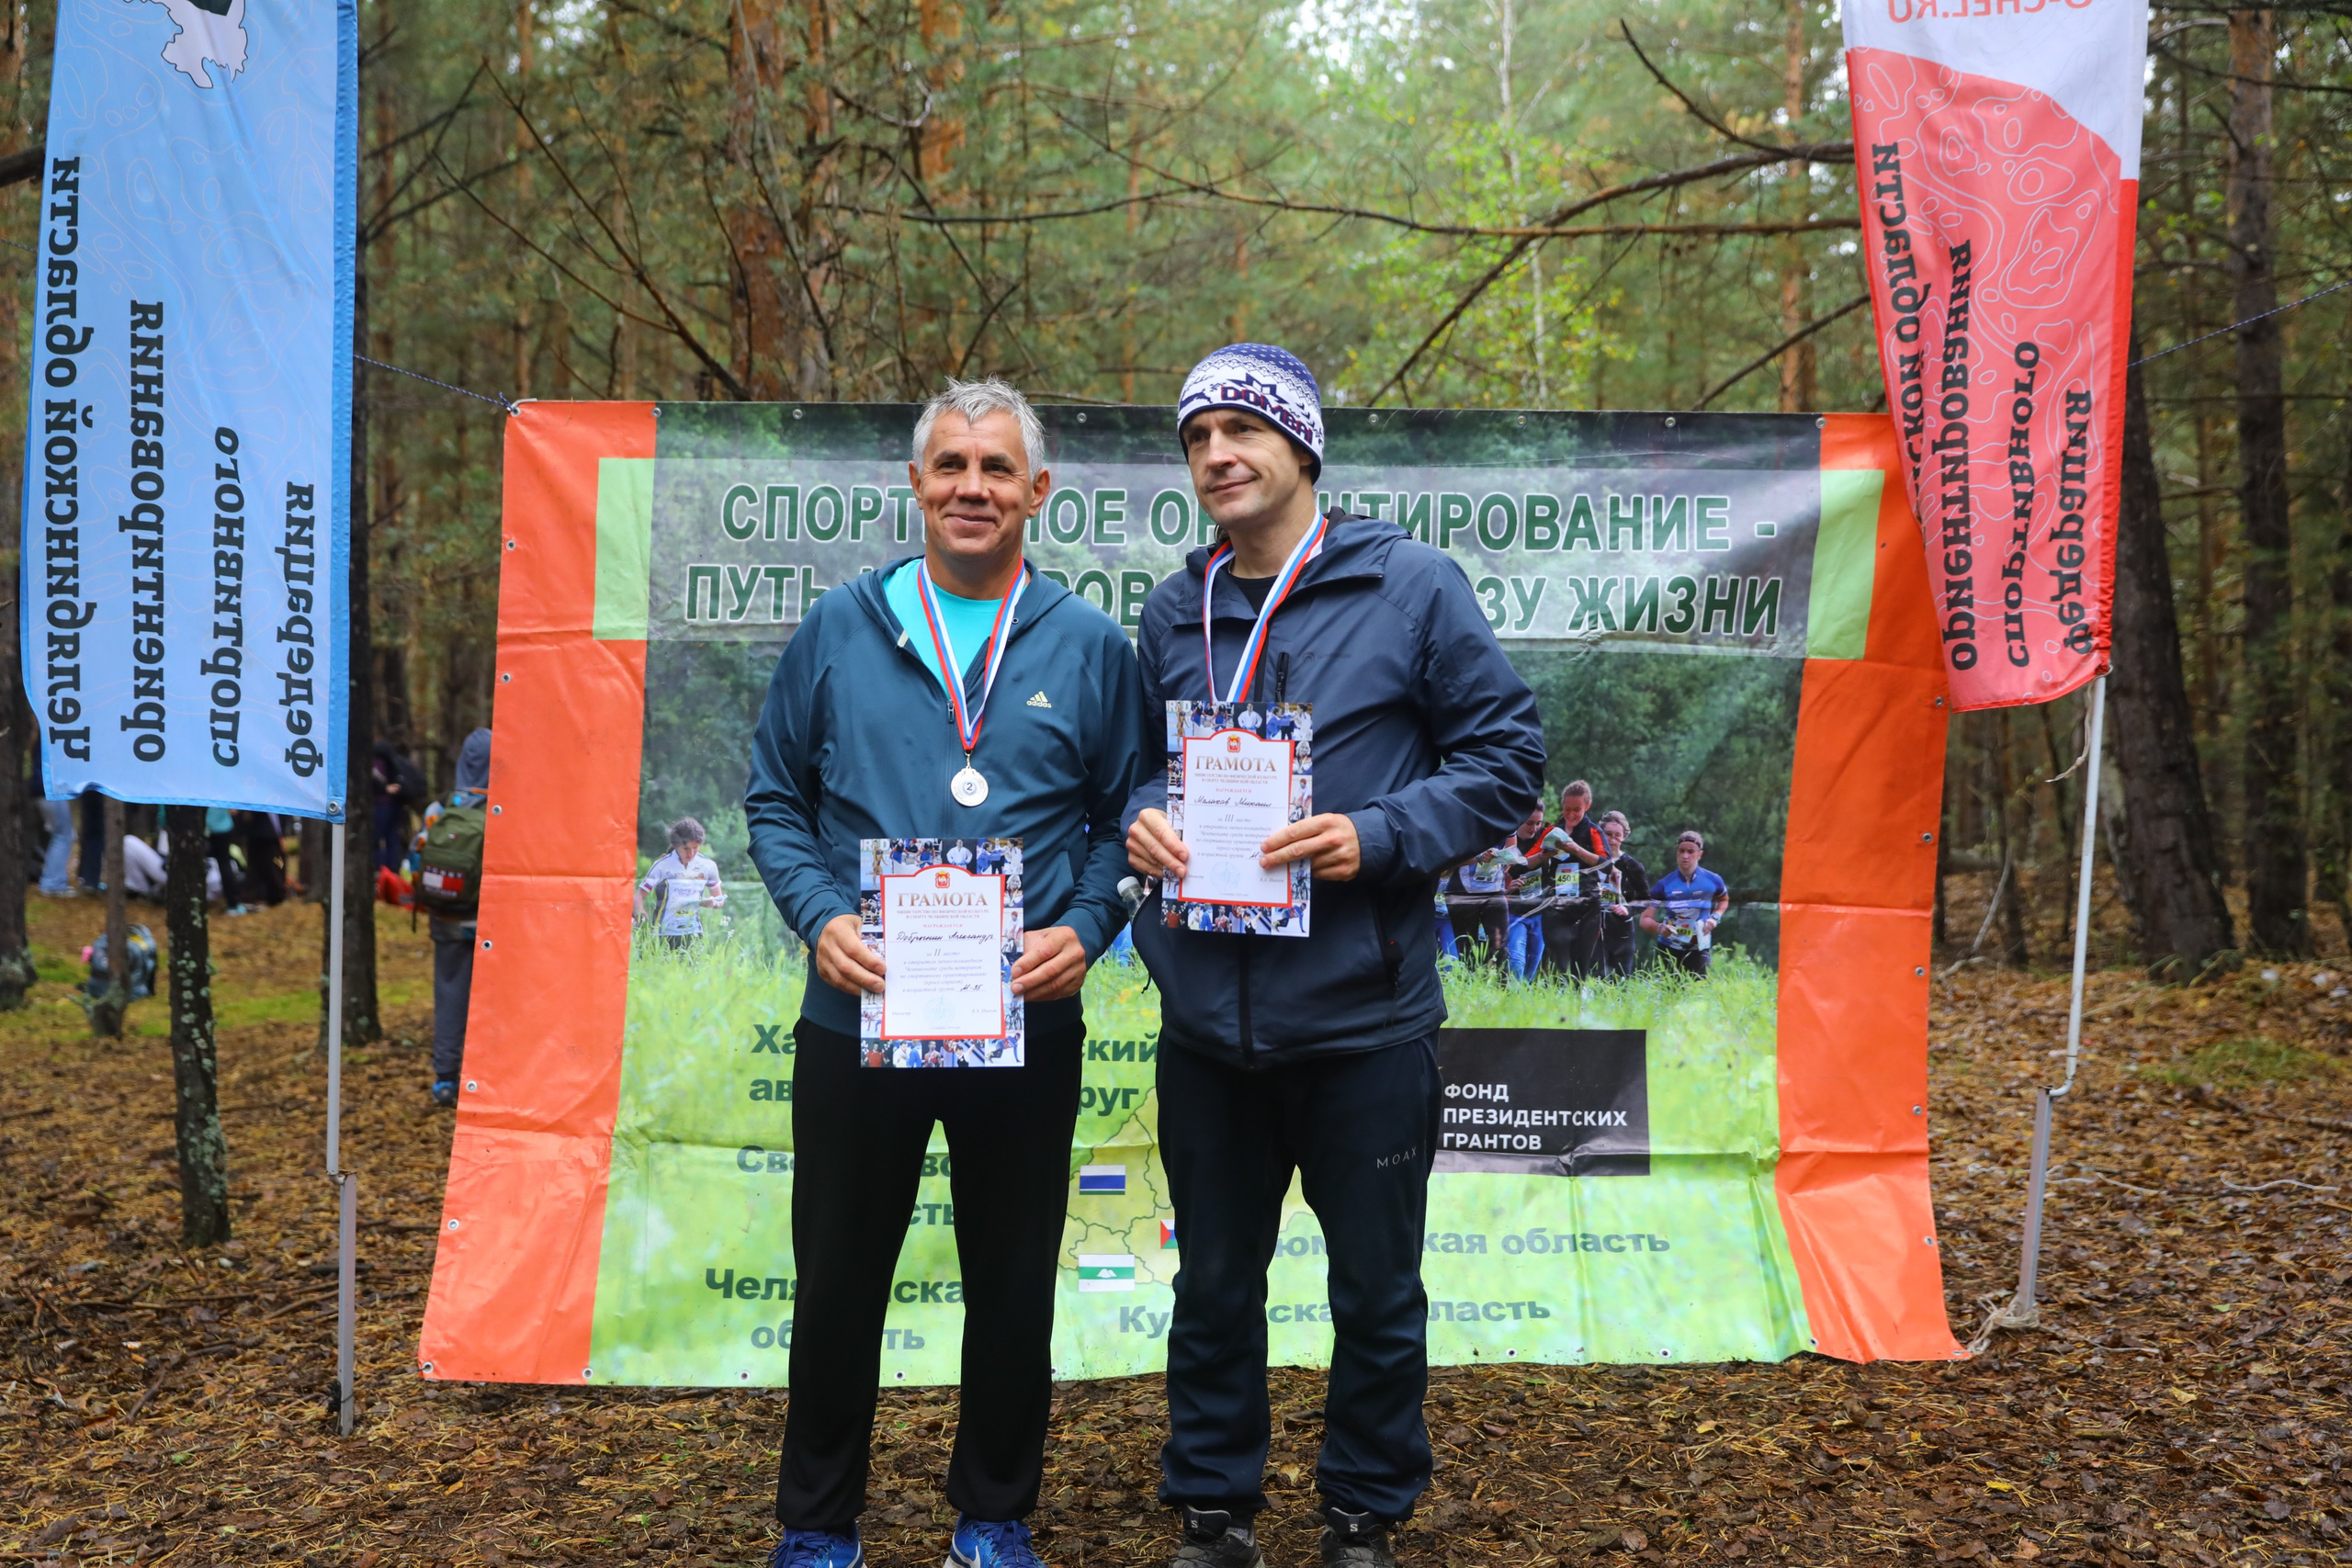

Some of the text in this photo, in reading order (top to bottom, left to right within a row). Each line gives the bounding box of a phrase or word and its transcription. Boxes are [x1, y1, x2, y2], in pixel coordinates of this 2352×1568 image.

[1567, 575, 1781, 637] ЖИЗНИ
[1026, 700, 1052, 709] adidas
[1195, 755, 1276, 773] ГРАМОТА
[967, 782, 973, 791] 2
[897, 892, 989, 907] ГРАМОТА
[1077, 1087, 1139, 1117] руг
[1443, 1083, 1510, 1104] ФОНД
[1442, 1107, 1628, 1129] ПРЕЗИДЕНТСКИХ
[1442, 1132, 1543, 1151] ГРАНТОВ
[1501, 1227, 1670, 1256] область
[1428, 1299, 1552, 1323] ласть
